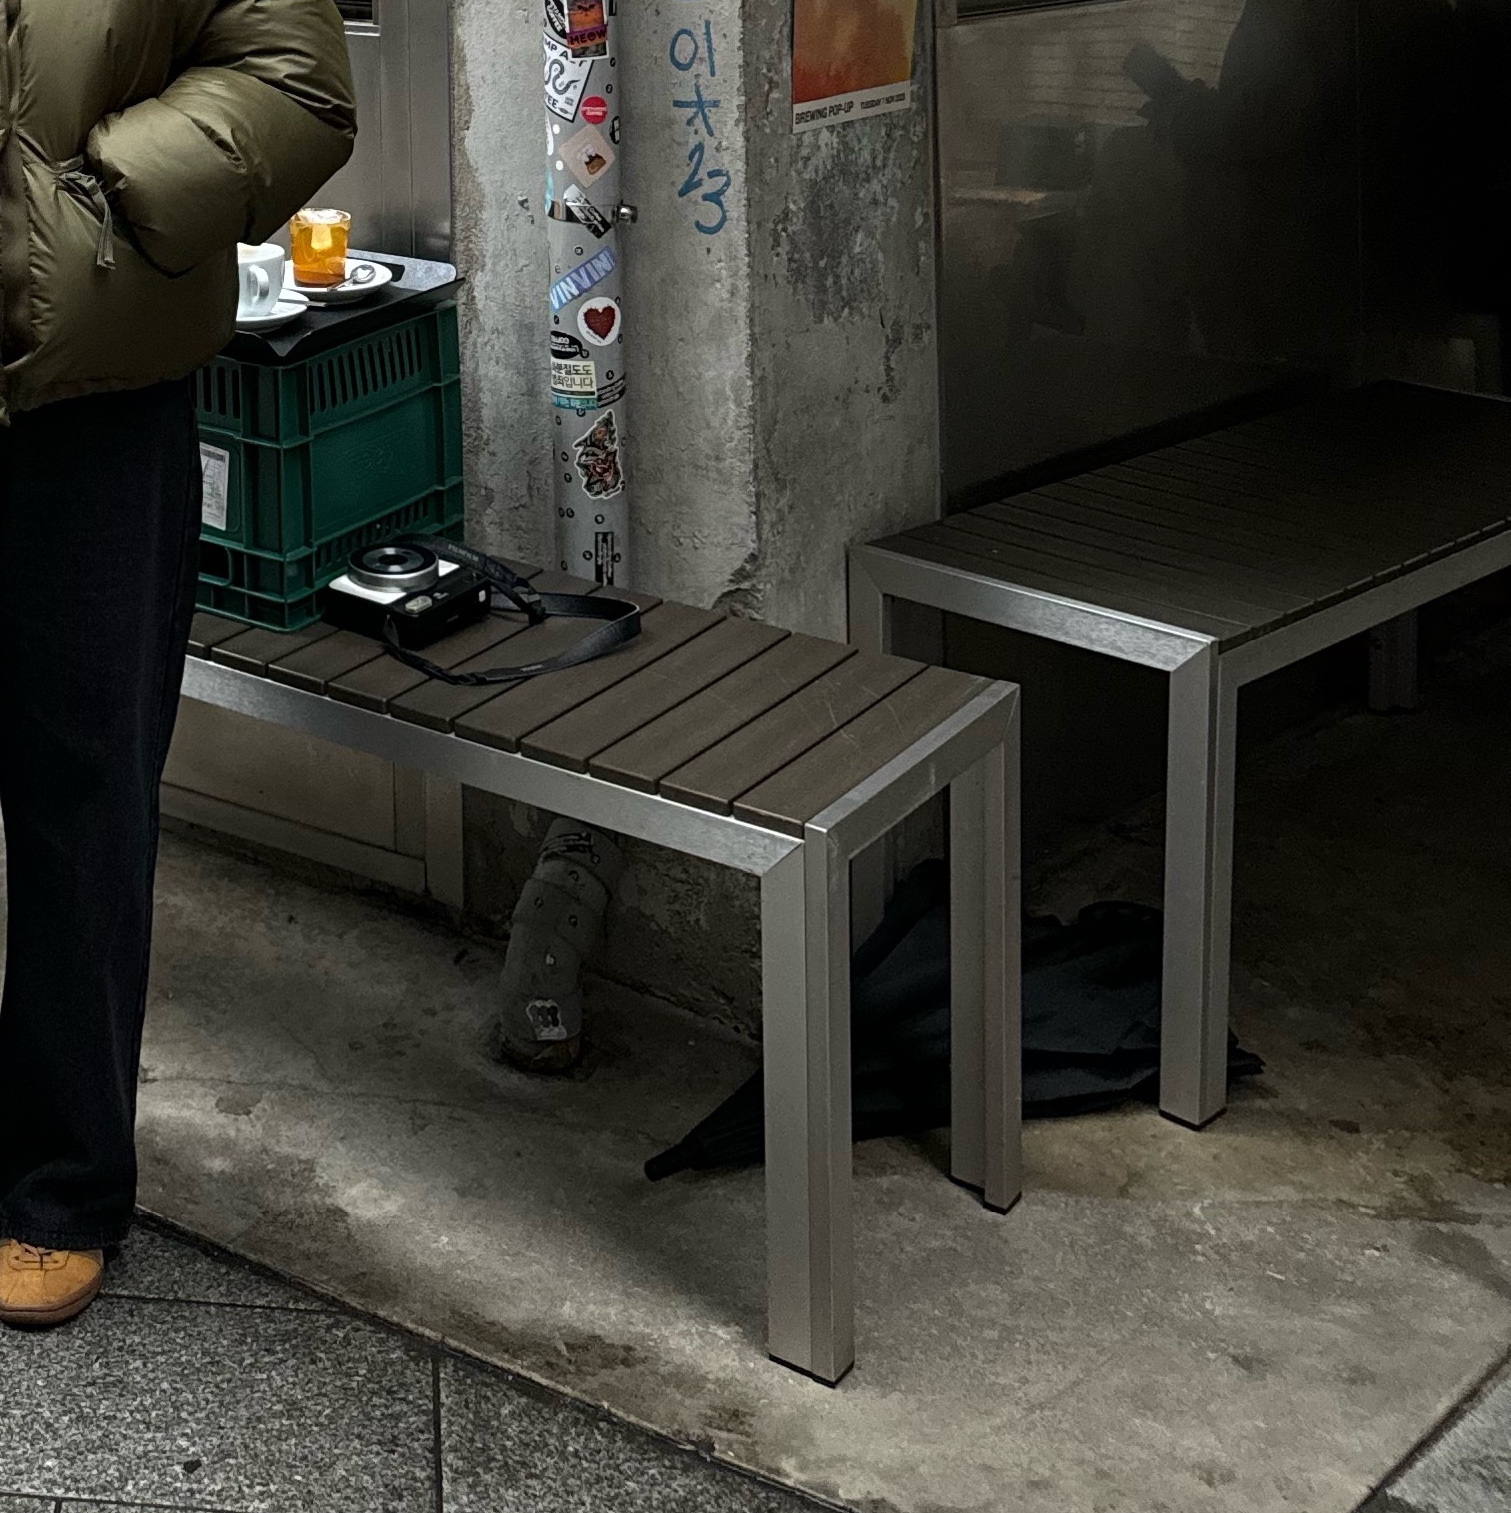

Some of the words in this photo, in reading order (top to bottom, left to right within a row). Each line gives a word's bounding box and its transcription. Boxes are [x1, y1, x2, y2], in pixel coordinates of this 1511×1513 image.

[568, 29, 608, 46] MEOW
[794, 106, 828, 125] BREWING
[828, 100, 854, 117] POP-UP
